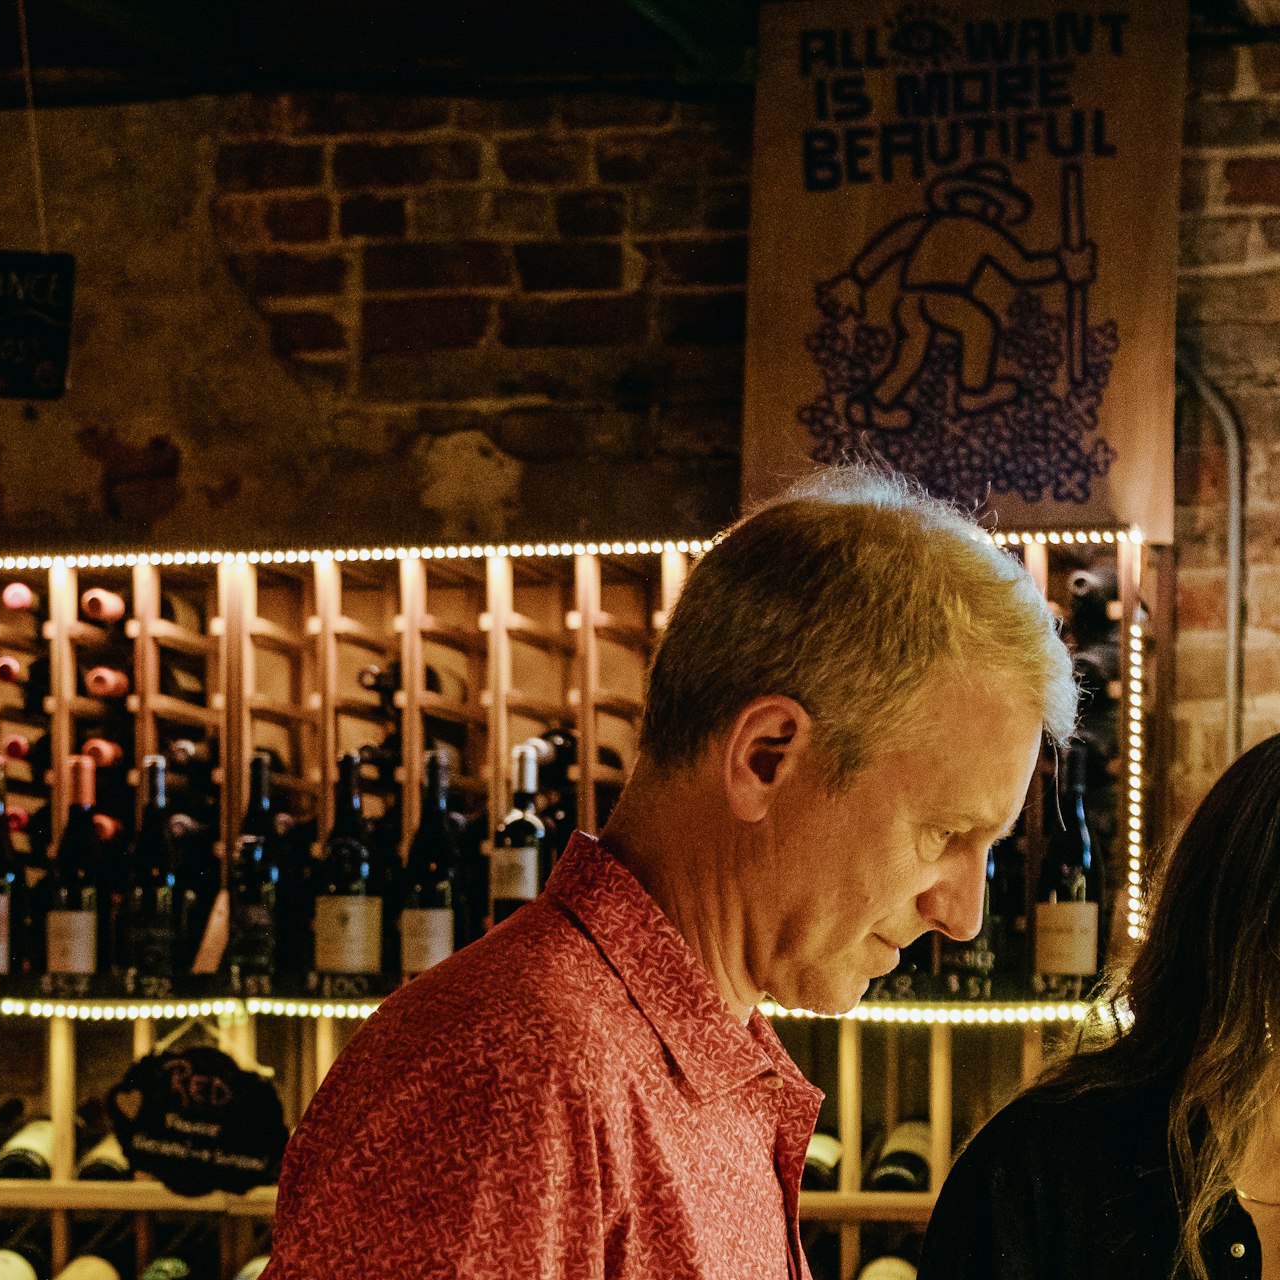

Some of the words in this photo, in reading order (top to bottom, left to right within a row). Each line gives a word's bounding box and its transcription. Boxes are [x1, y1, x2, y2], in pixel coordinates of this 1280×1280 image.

[799, 28, 888, 76] ALL
[964, 13, 1129, 65] WANT
[817, 73, 870, 121] IS
[894, 62, 1077, 118] MORE
[803, 108, 1118, 192] BEAUTIFUL
[163, 1058, 232, 1107] RED
